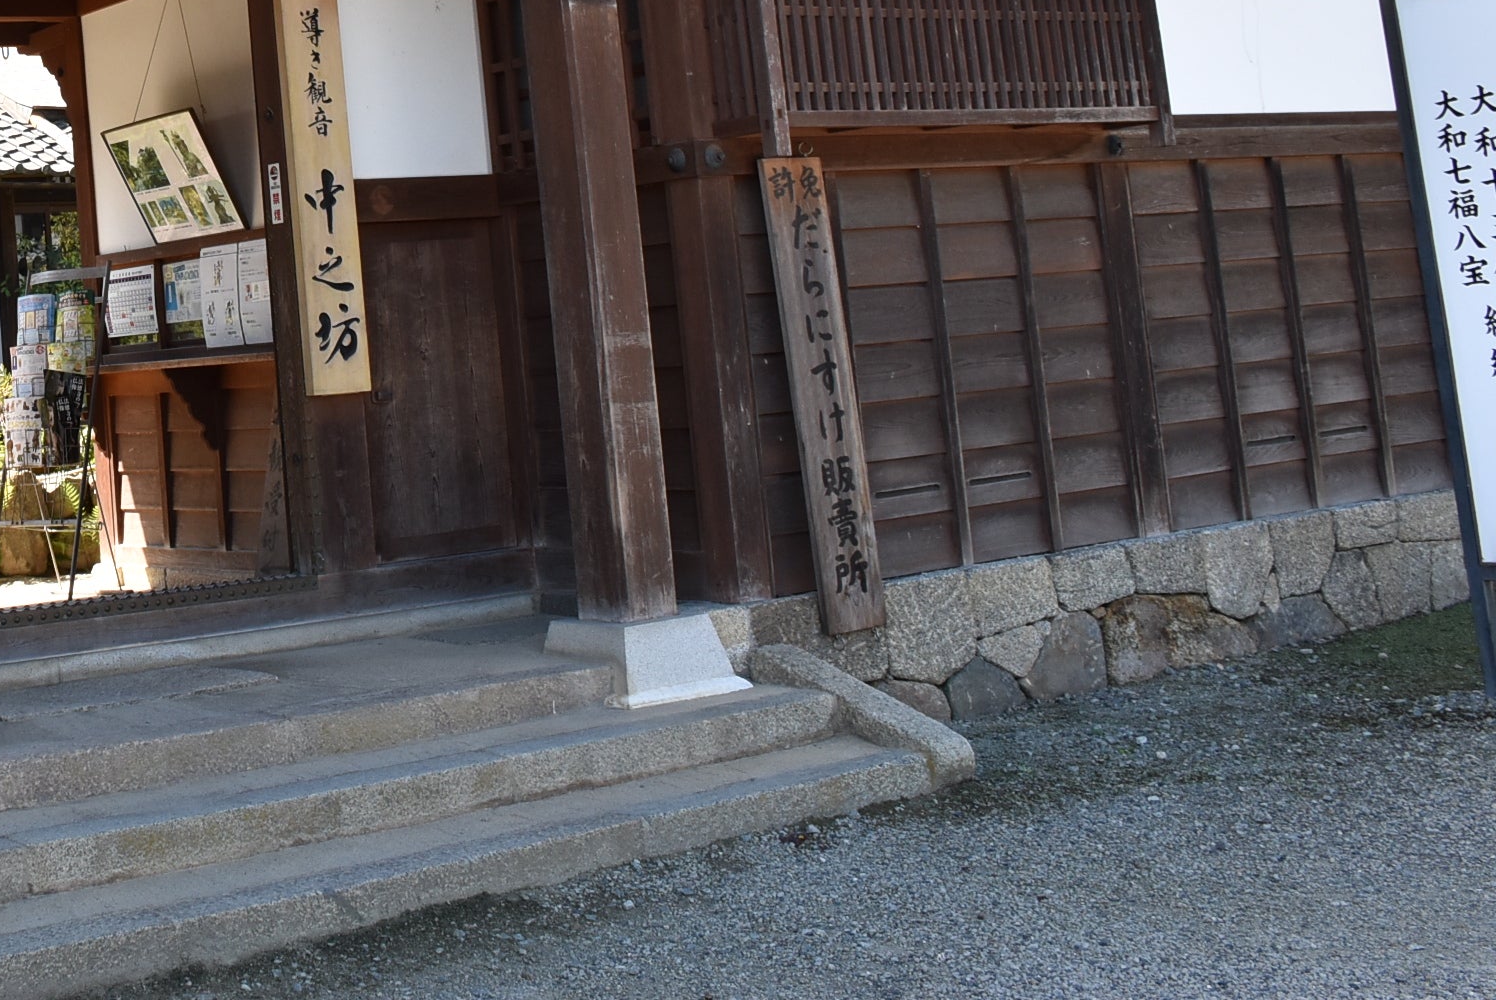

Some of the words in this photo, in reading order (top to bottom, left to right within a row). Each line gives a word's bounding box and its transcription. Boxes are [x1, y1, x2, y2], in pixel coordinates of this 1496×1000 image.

[299, 7, 334, 138] 導き観音
[304, 168, 362, 365] 中之坊
[1434, 90, 1491, 287] 大和七福八宝
